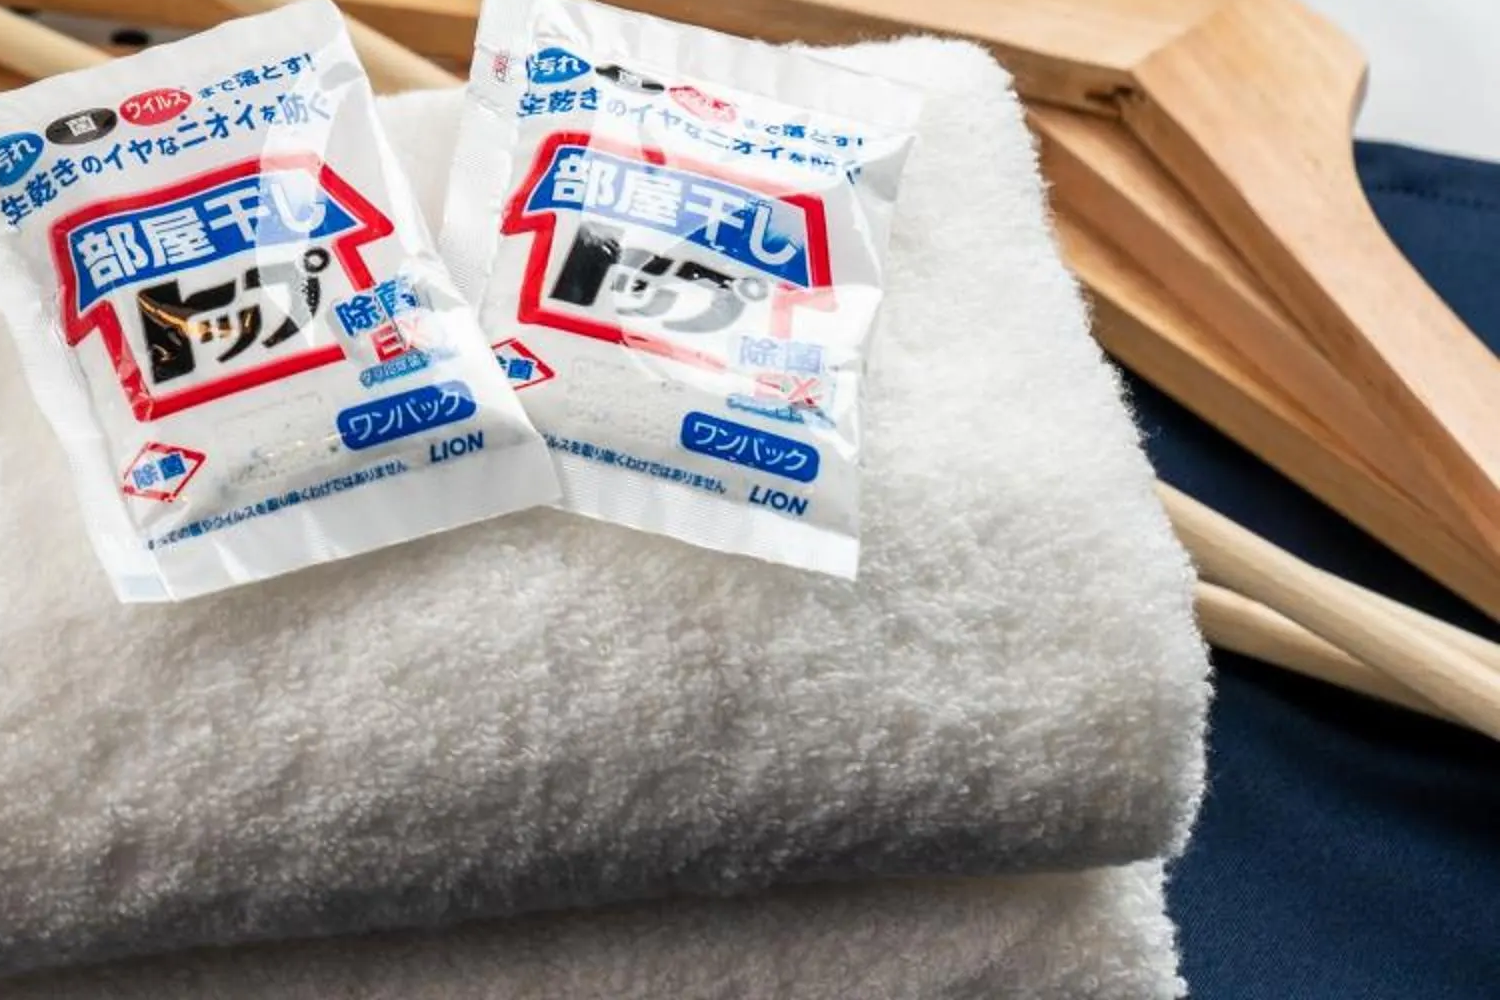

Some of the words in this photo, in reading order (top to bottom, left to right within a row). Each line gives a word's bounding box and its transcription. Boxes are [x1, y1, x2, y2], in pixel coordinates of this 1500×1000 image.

[0, 90, 331, 226] 生乾きのイヤなニオイを防ぐ
[123, 90, 188, 121] ウイルス
[77, 182, 327, 287] 部屋干し
[551, 153, 797, 265] 部屋干し
[138, 248, 330, 384] トップ
[548, 221, 769, 334] トップ
[429, 430, 484, 463] LION
[750, 485, 809, 516] LION
